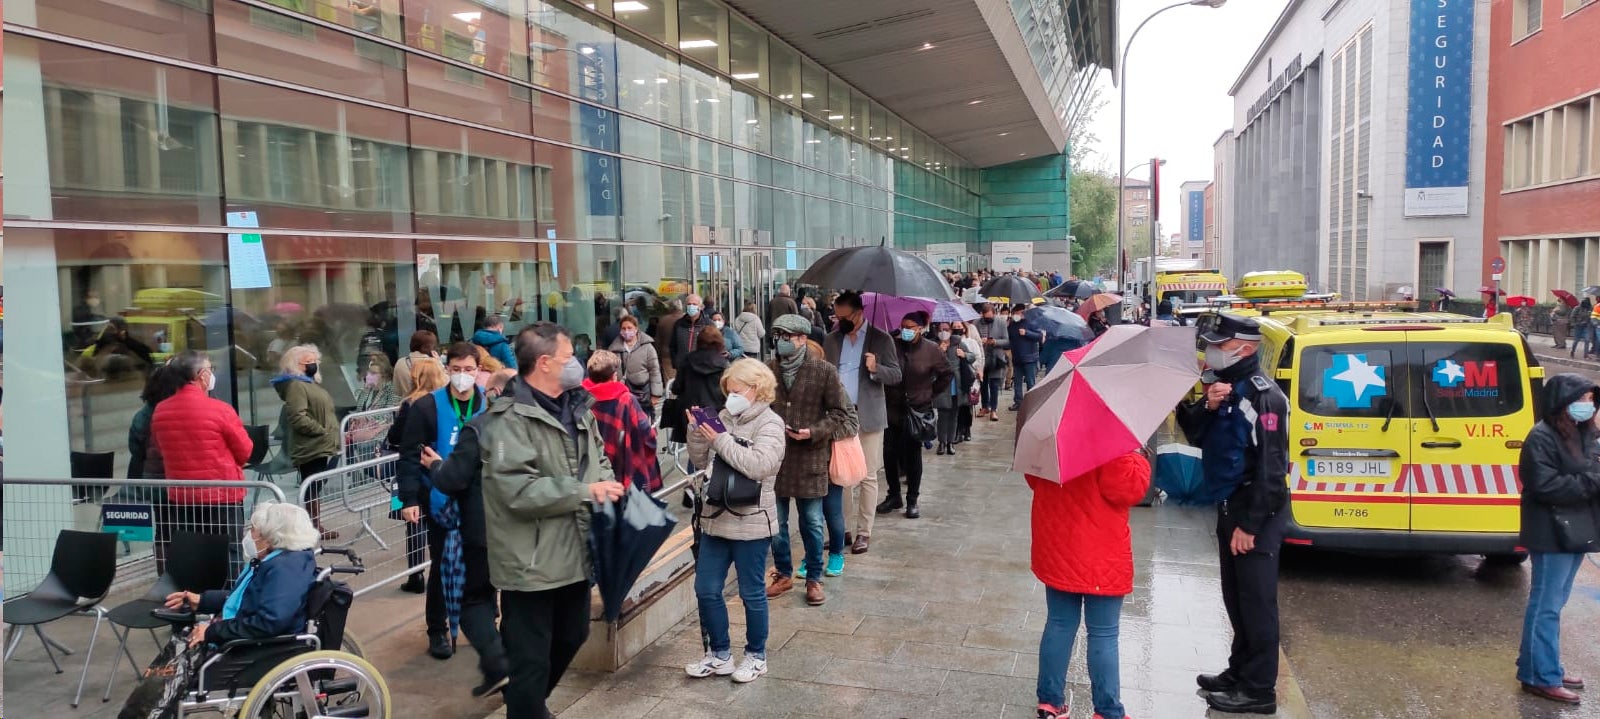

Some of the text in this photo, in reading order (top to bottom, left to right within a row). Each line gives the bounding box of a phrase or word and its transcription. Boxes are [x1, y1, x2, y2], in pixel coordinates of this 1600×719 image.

[1432, 0, 1447, 168] SEGURIDAD
[1464, 424, 1509, 438] V.I.R.
[1317, 461, 1387, 474] 6189 JHL
[105, 511, 149, 520] SEGURIDAD
[1334, 508, 1369, 518] M-786
